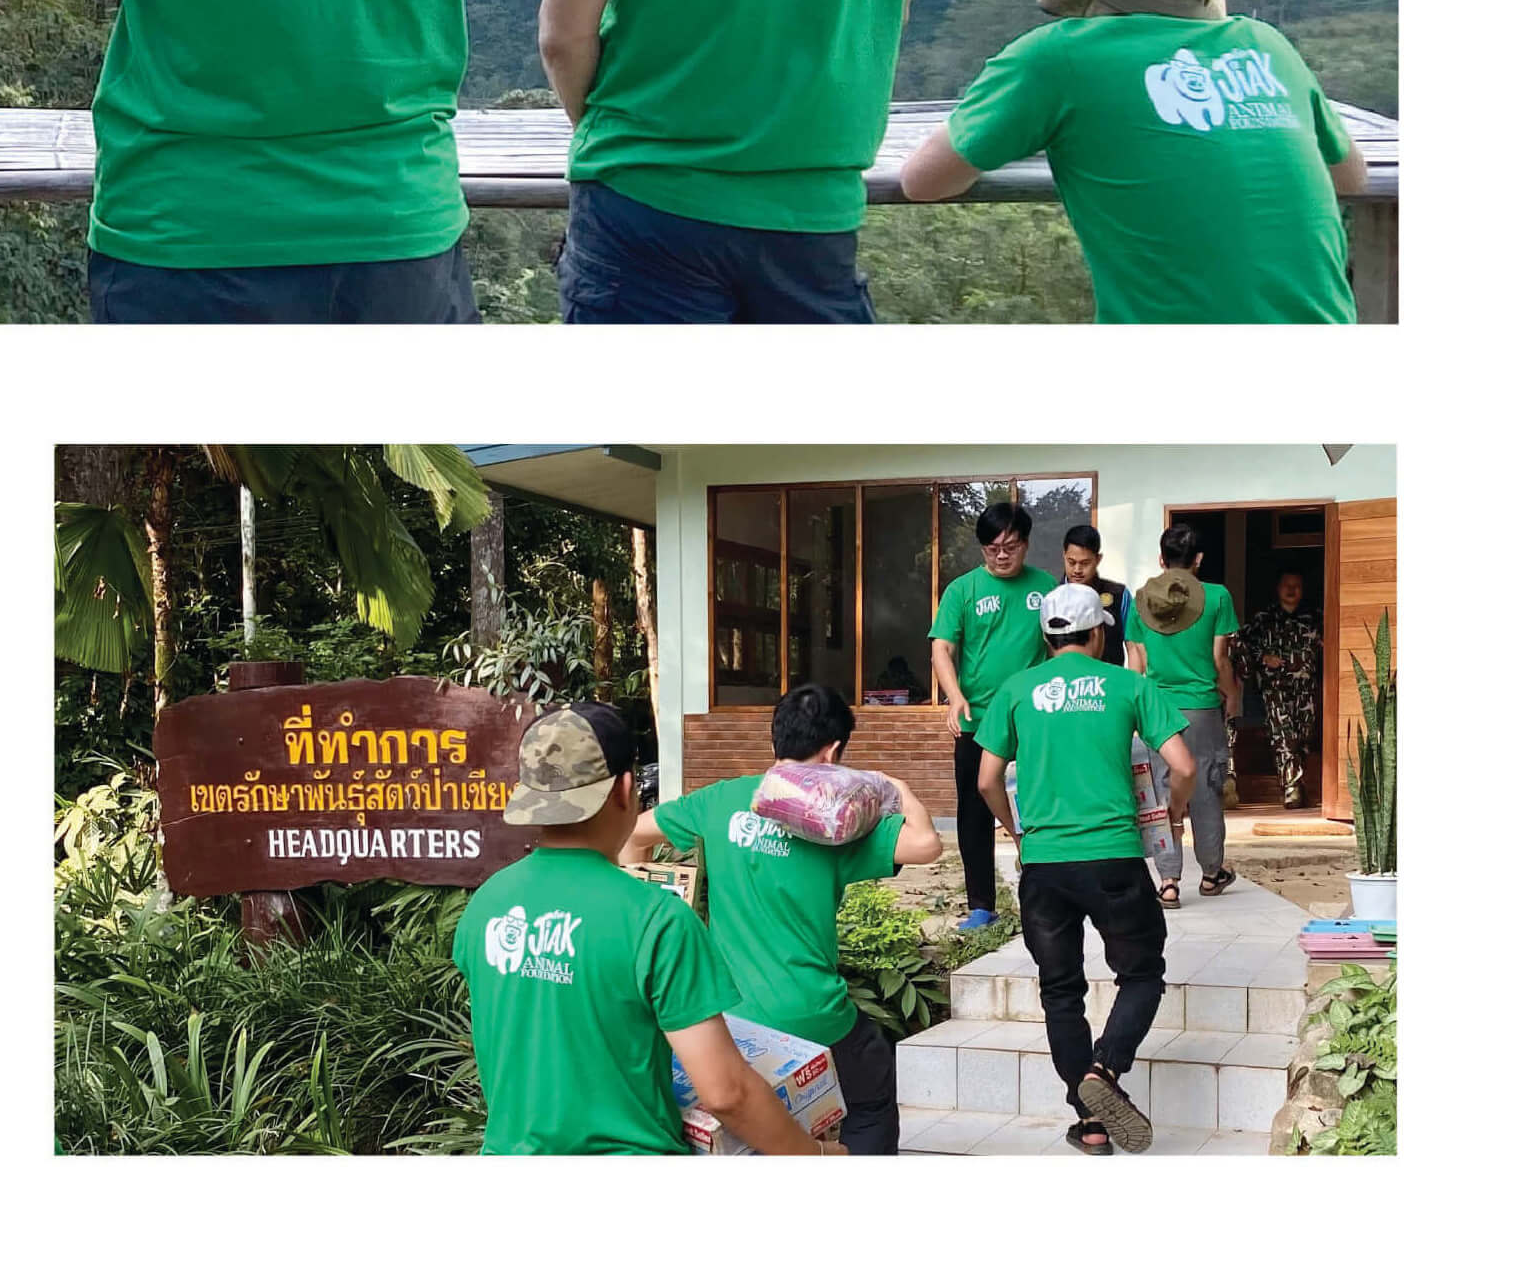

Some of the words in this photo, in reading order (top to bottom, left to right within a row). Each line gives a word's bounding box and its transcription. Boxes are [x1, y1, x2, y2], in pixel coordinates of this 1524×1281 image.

[283, 704, 468, 765] ที่ทำการ
[190, 769, 520, 827] เขตรักษาพันธุ์สัตว์ป่าเชีย
[268, 829, 482, 866] HEADQUARTERS
